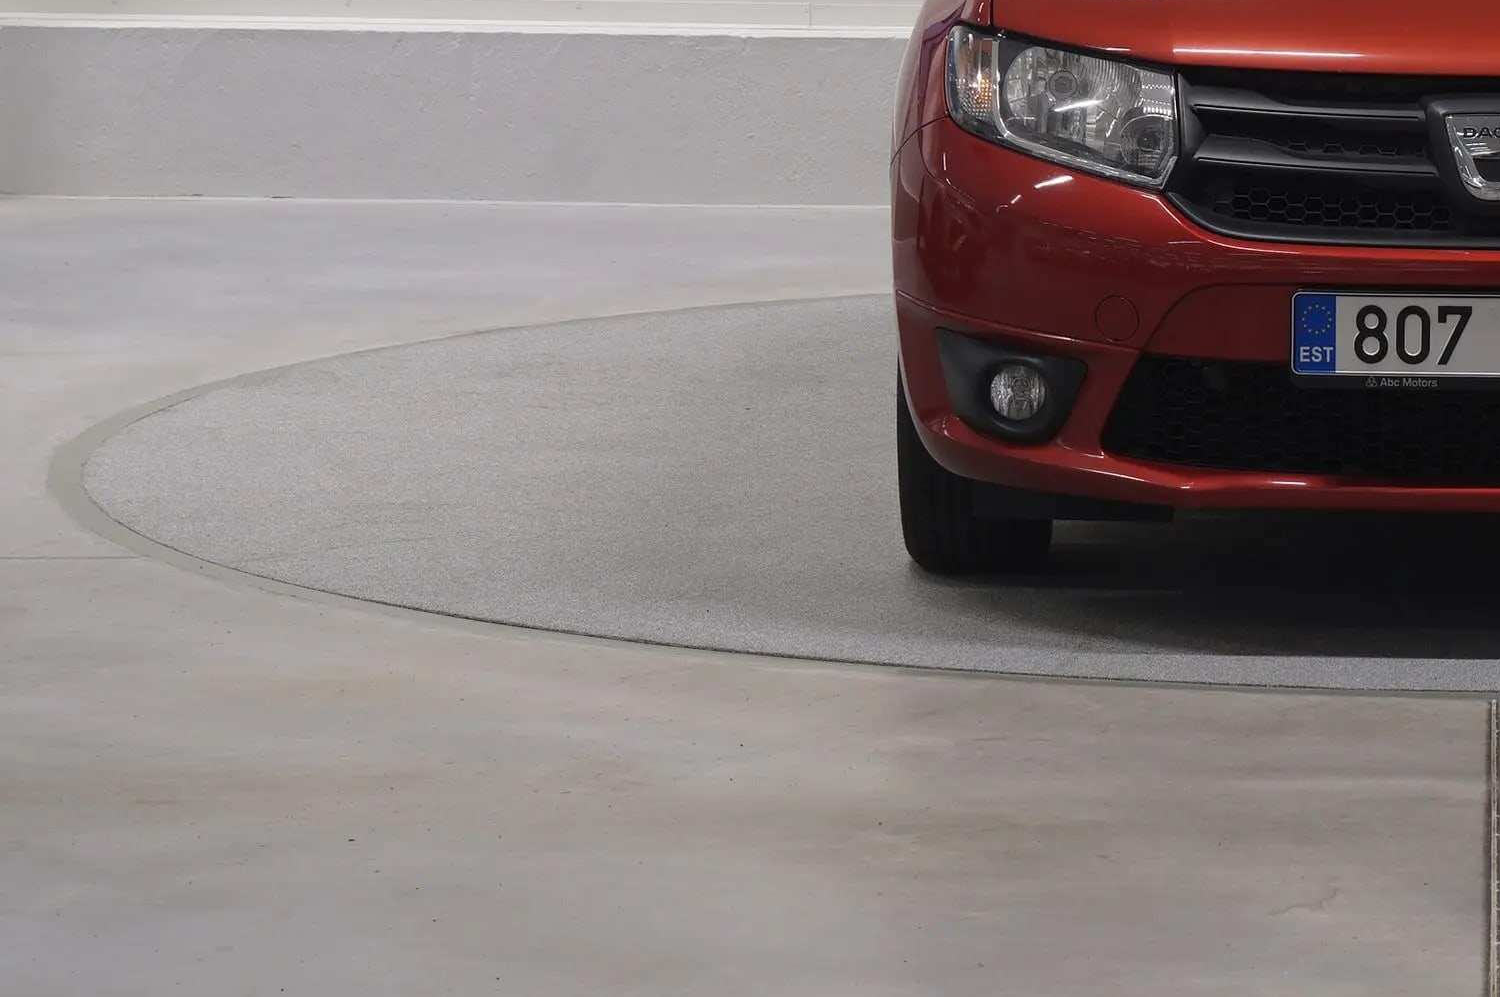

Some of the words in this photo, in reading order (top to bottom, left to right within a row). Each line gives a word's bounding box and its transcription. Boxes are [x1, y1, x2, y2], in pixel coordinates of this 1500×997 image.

[1353, 304, 1473, 366] 807
[1299, 346, 1334, 363] EST
[1380, 377, 1400, 387] Abc
[1402, 377, 1438, 388] Motors
